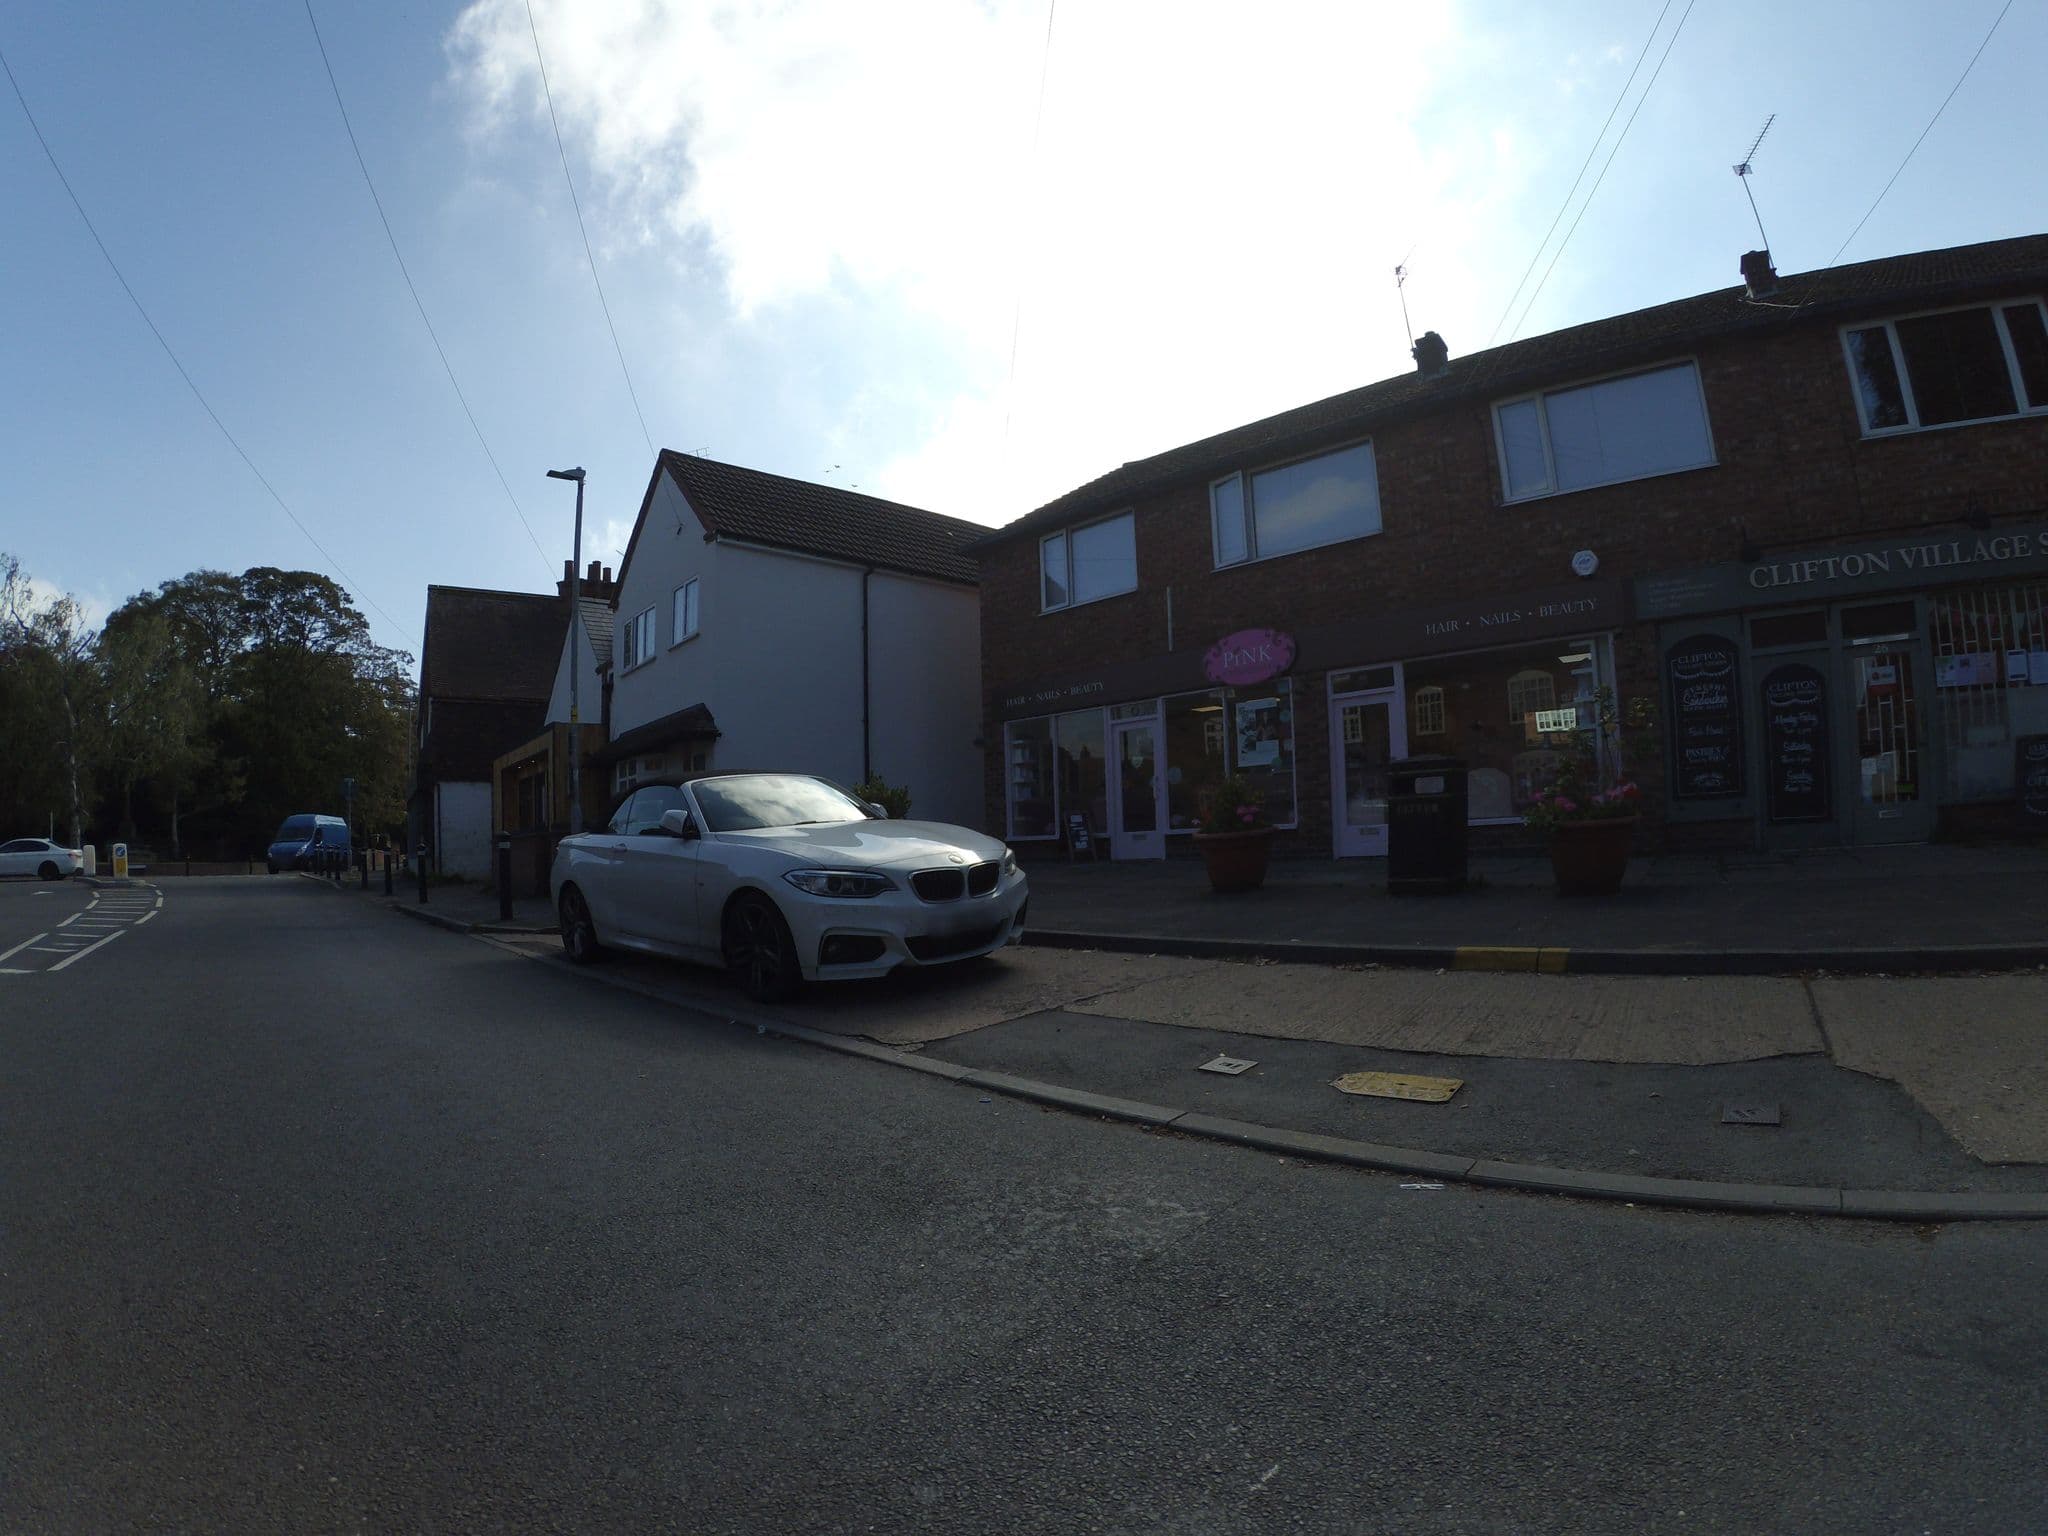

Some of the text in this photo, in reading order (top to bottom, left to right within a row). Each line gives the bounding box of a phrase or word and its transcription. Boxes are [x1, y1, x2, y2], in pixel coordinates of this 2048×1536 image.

[1749, 550, 1889, 589] CLIFTON
[1896, 534, 2033, 570] VILLAGE
[1425, 599, 1598, 636] HAIR NAILS BEAUTY
